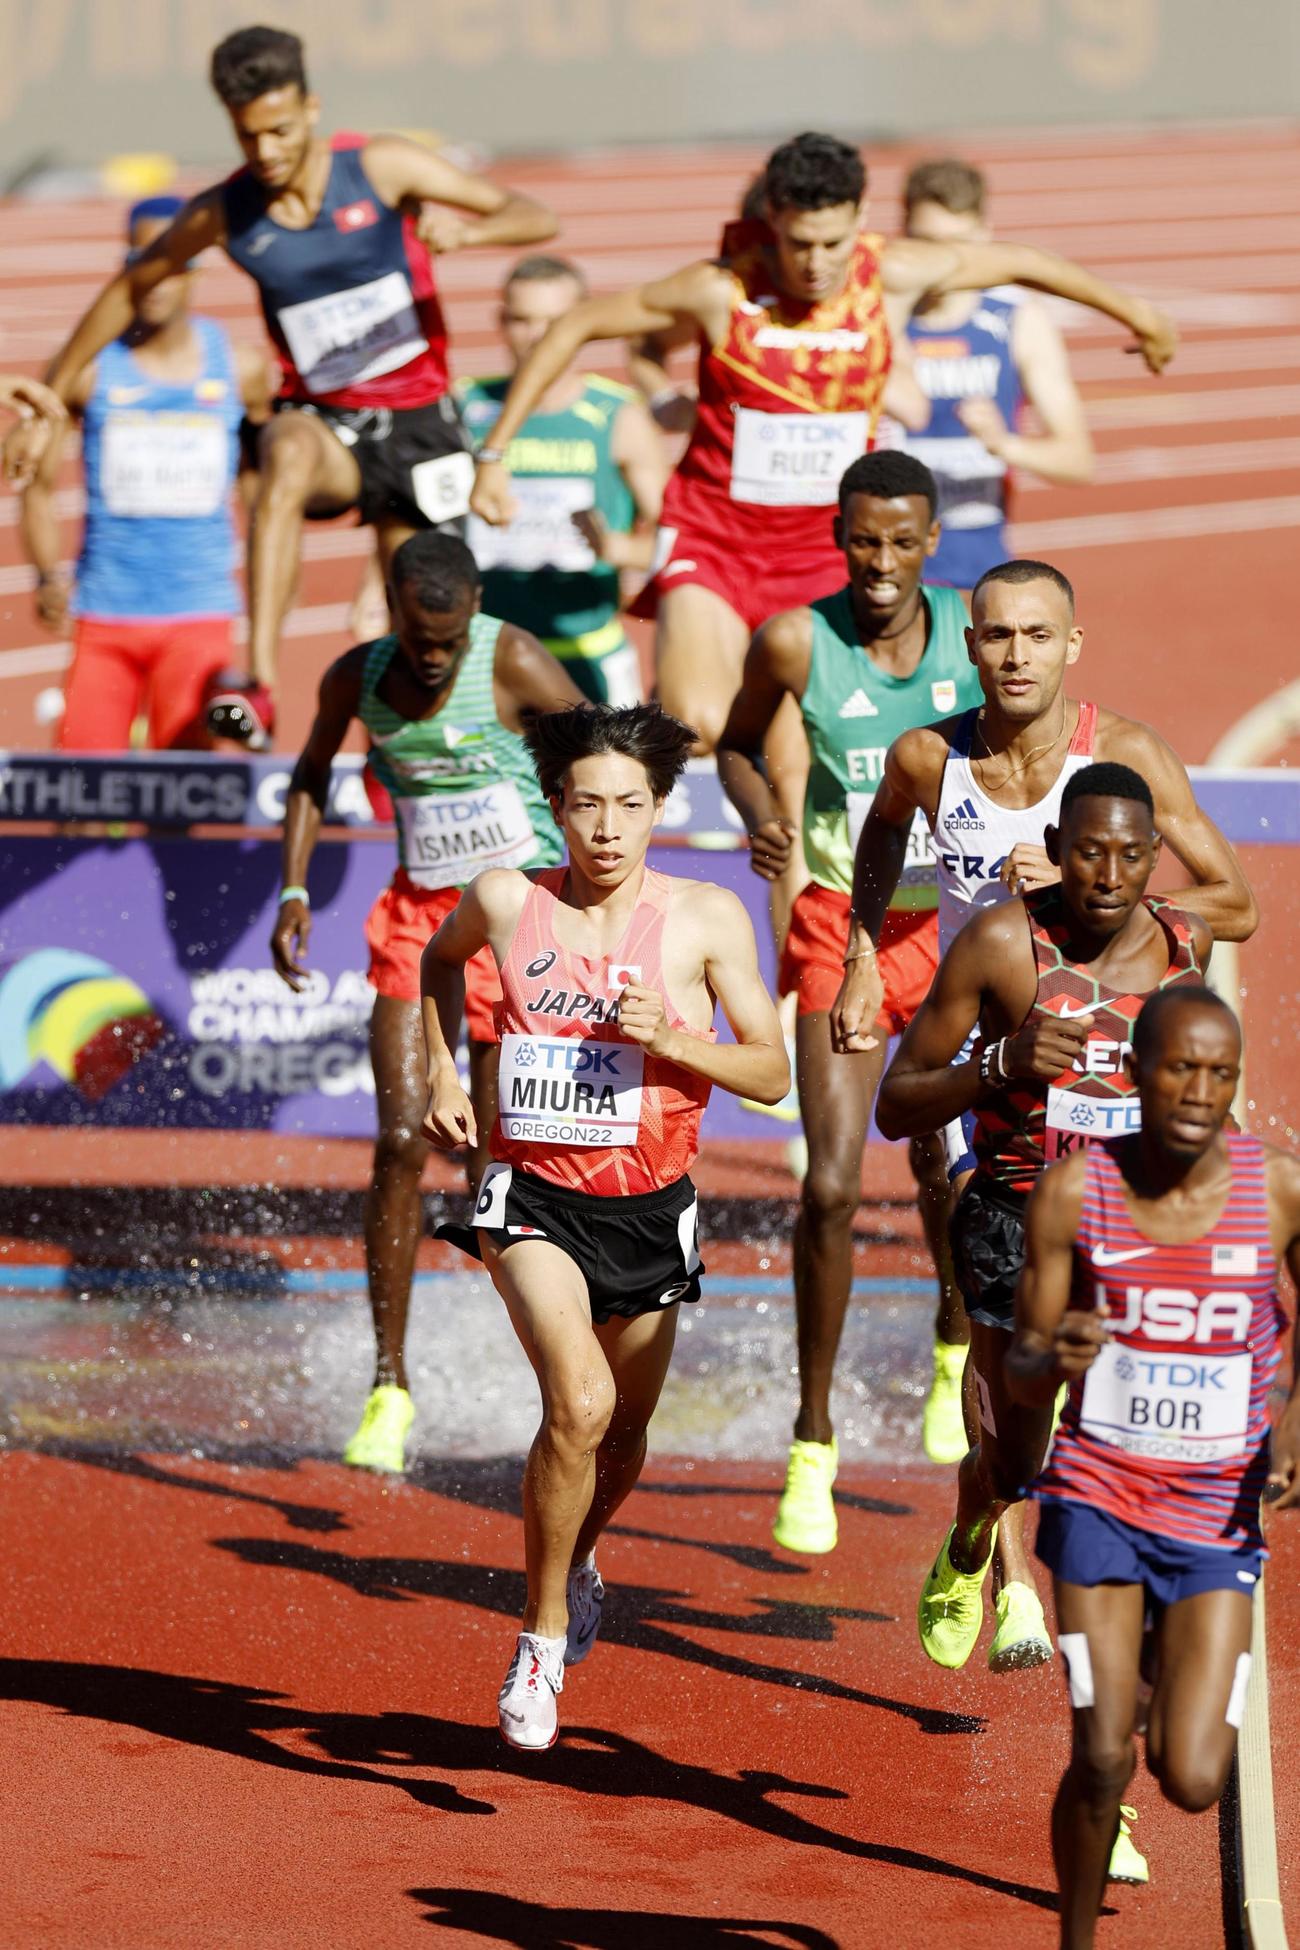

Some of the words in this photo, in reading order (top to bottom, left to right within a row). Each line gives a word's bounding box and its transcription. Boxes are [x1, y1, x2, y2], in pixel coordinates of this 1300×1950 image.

[784, 424, 847, 444] TDK
[770, 450, 834, 476] RUIZ
[430, 794, 497, 823] TDK
[944, 818, 985, 831] adidas
[415, 822, 514, 862] ISMAIL
[538, 1043, 621, 1075] TDK
[511, 1077, 618, 1117] MIURA
[510, 1121, 613, 1143] OREGON22
[476, 1174, 496, 1215] 6
[1096, 1284, 1253, 1343] USA
[1138, 1361, 1226, 1390] TDK
[1129, 1396, 1203, 1431] BOR
